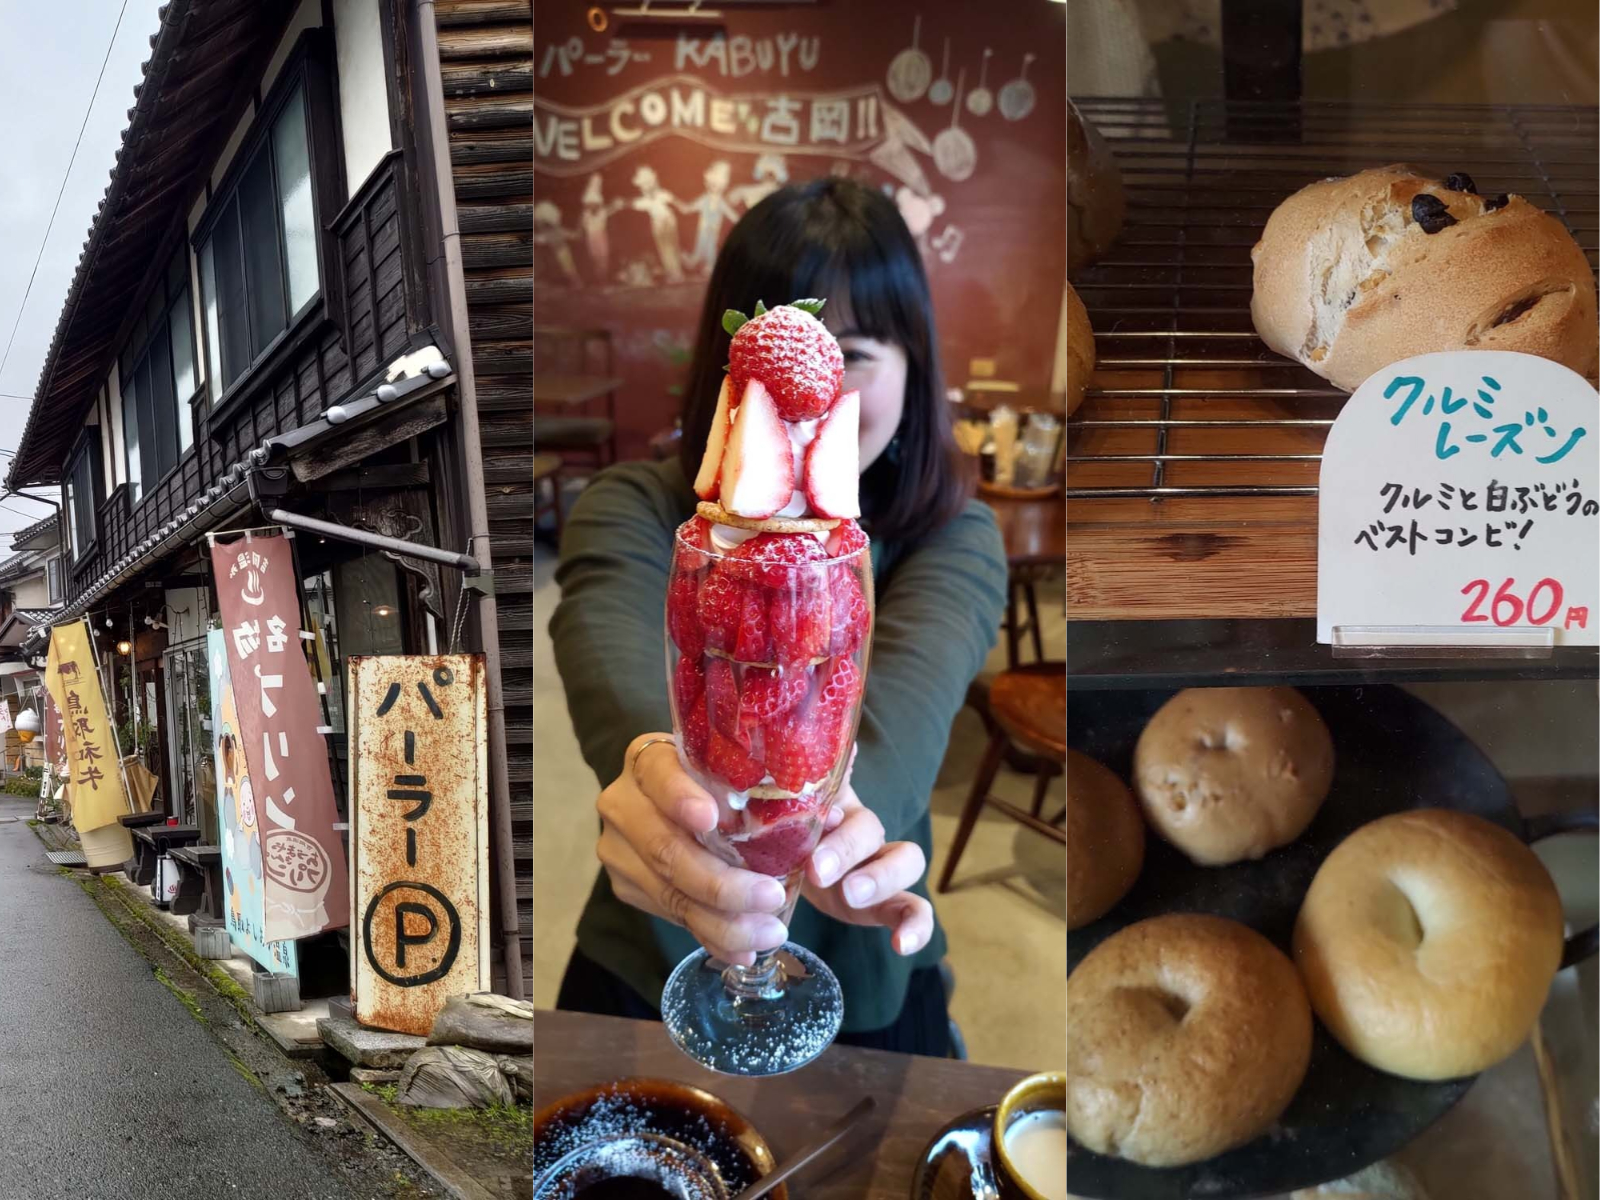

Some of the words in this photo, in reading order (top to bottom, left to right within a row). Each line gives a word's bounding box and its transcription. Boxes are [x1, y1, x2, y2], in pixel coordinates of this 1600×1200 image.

[540, 36, 651, 77] パーラー
[675, 31, 821, 77] KABUYU
[1383, 376, 1501, 426] クルミ
[1435, 406, 1587, 464] レーズン
[1380, 478, 1599, 516] クルミと白ぶどうの
[1354, 519, 1534, 555] ベストコンビ!
[1460, 577, 1589, 630] 260円
[376, 666, 454, 868] パーラー
